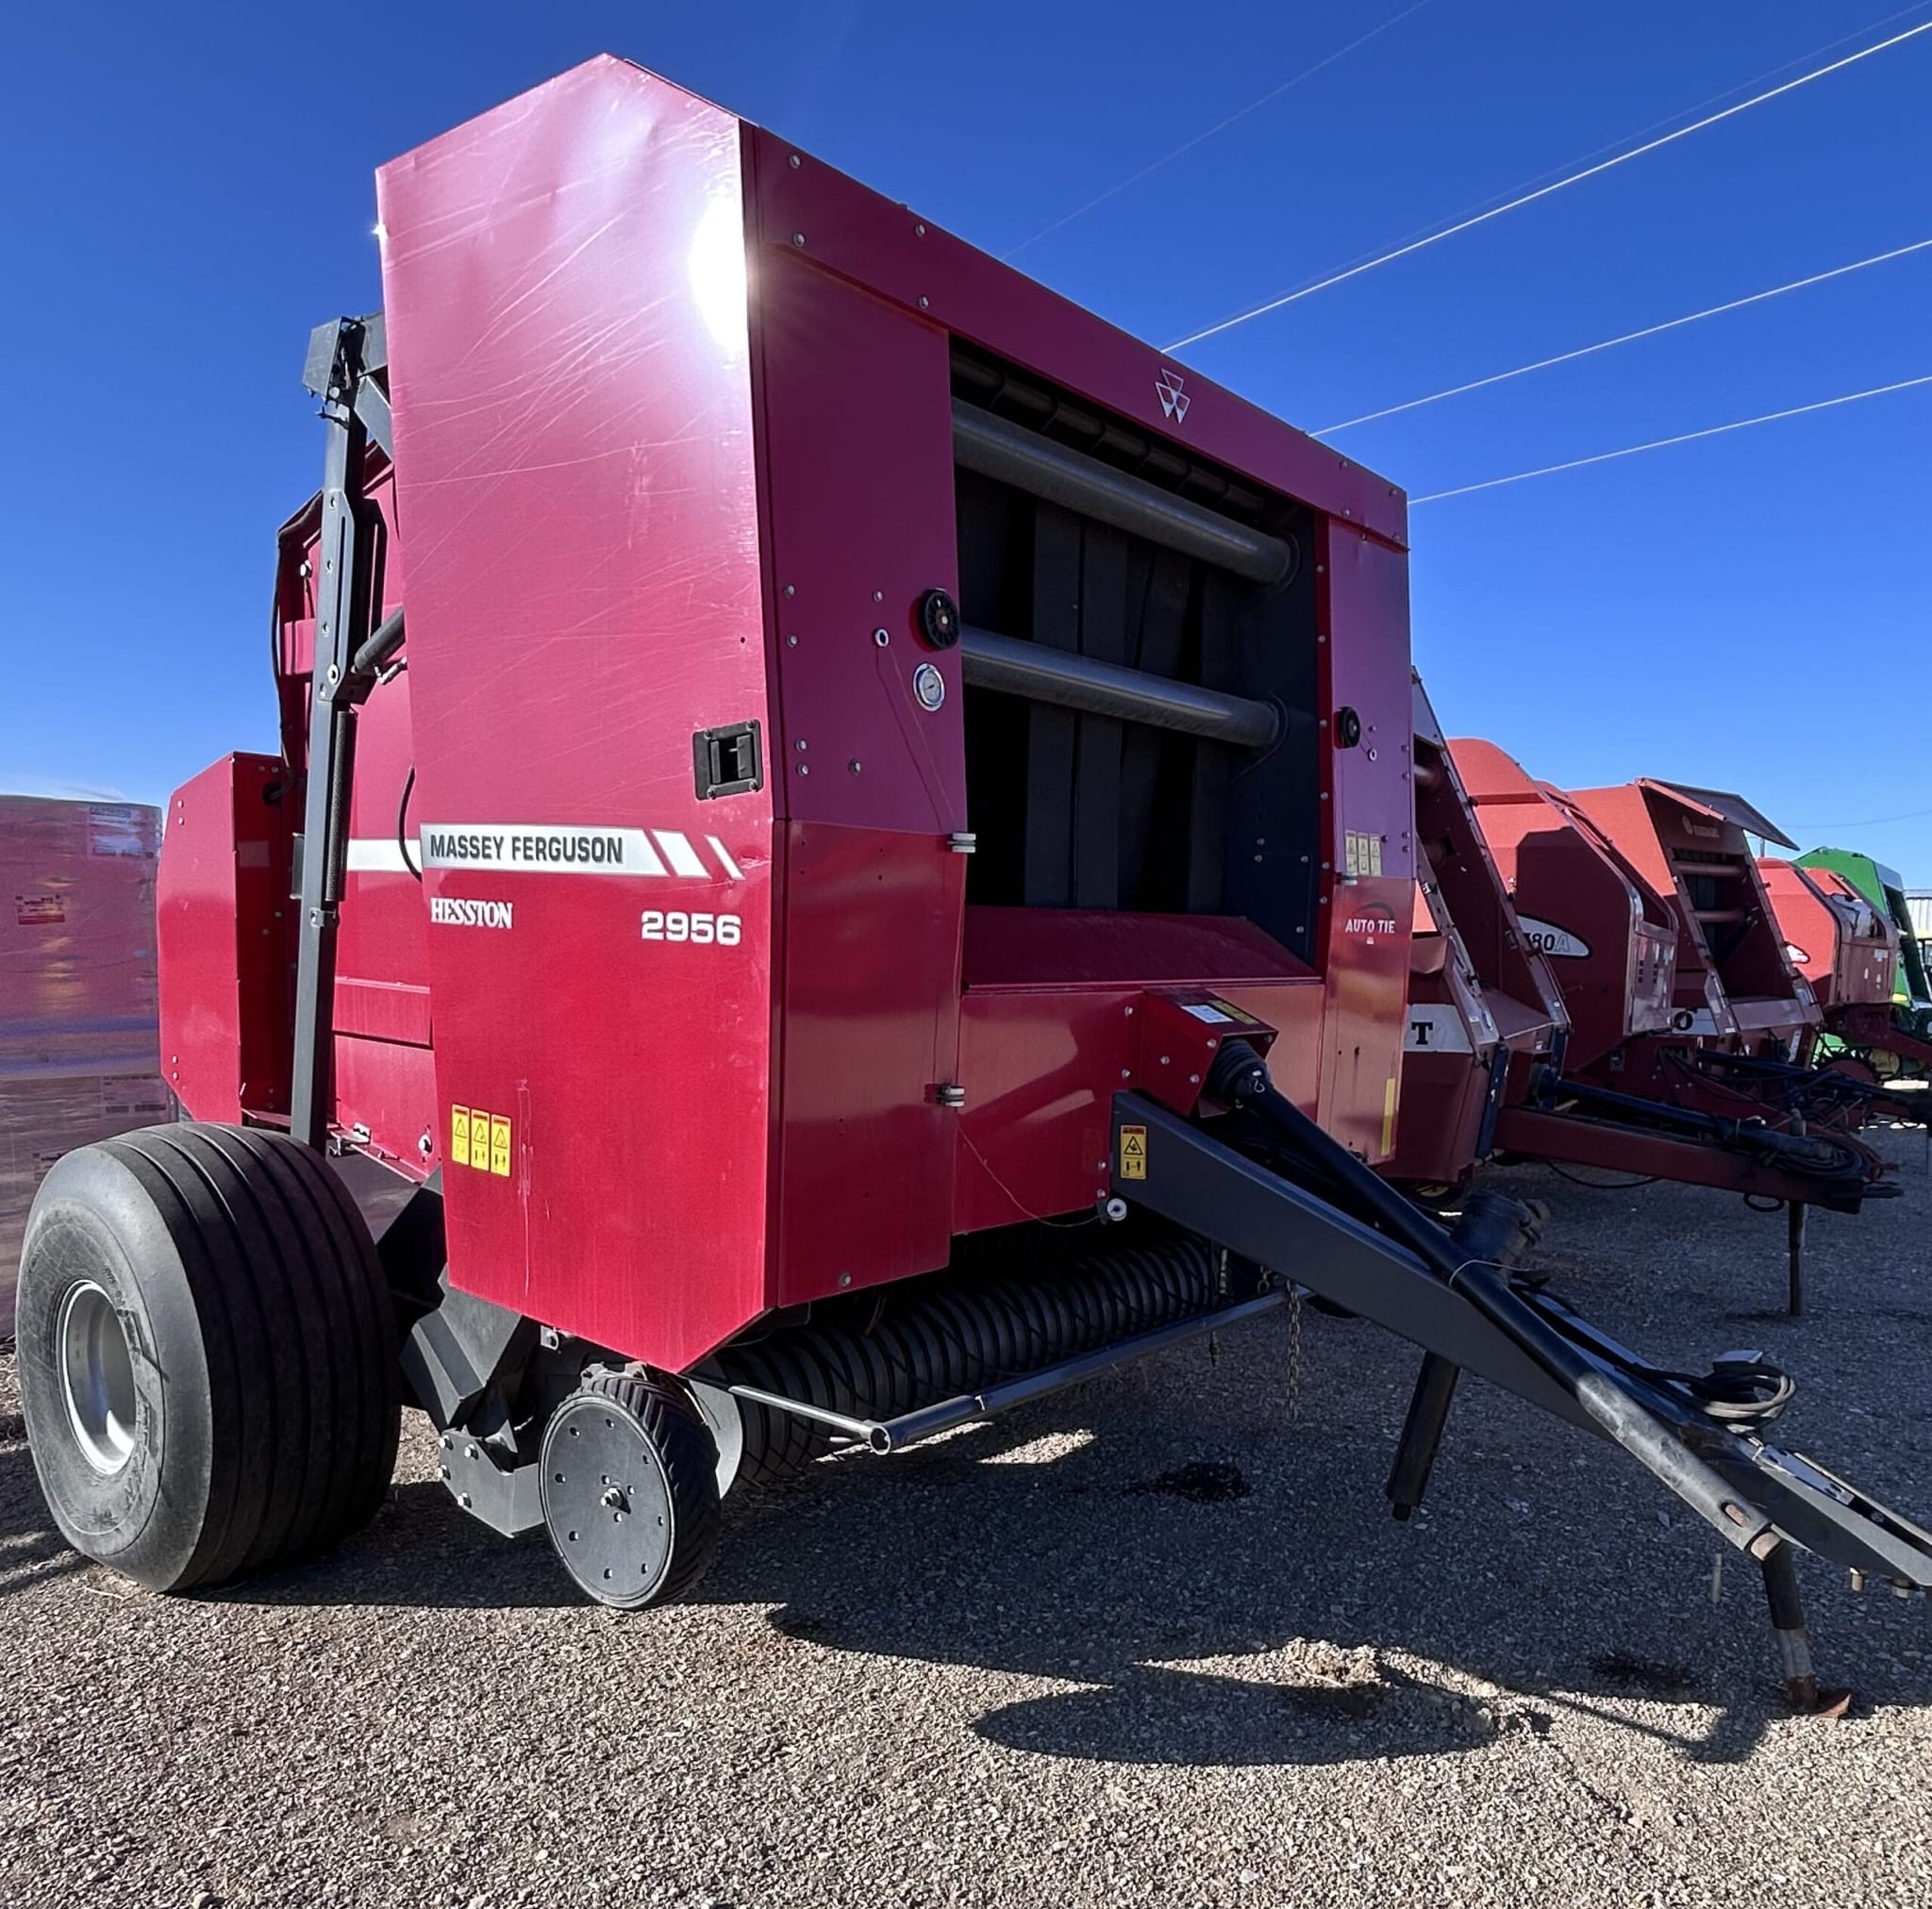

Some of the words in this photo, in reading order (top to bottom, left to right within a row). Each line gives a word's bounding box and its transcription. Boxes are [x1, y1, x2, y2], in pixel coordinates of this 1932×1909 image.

[430, 835, 504, 860] MASSEY
[511, 836, 624, 864] FERGUSON
[430, 897, 513, 929] HESSTON
[641, 910, 741, 946] 2956
[1344, 919, 1375, 934] AUTO
[1377, 920, 1396, 934] TIE
